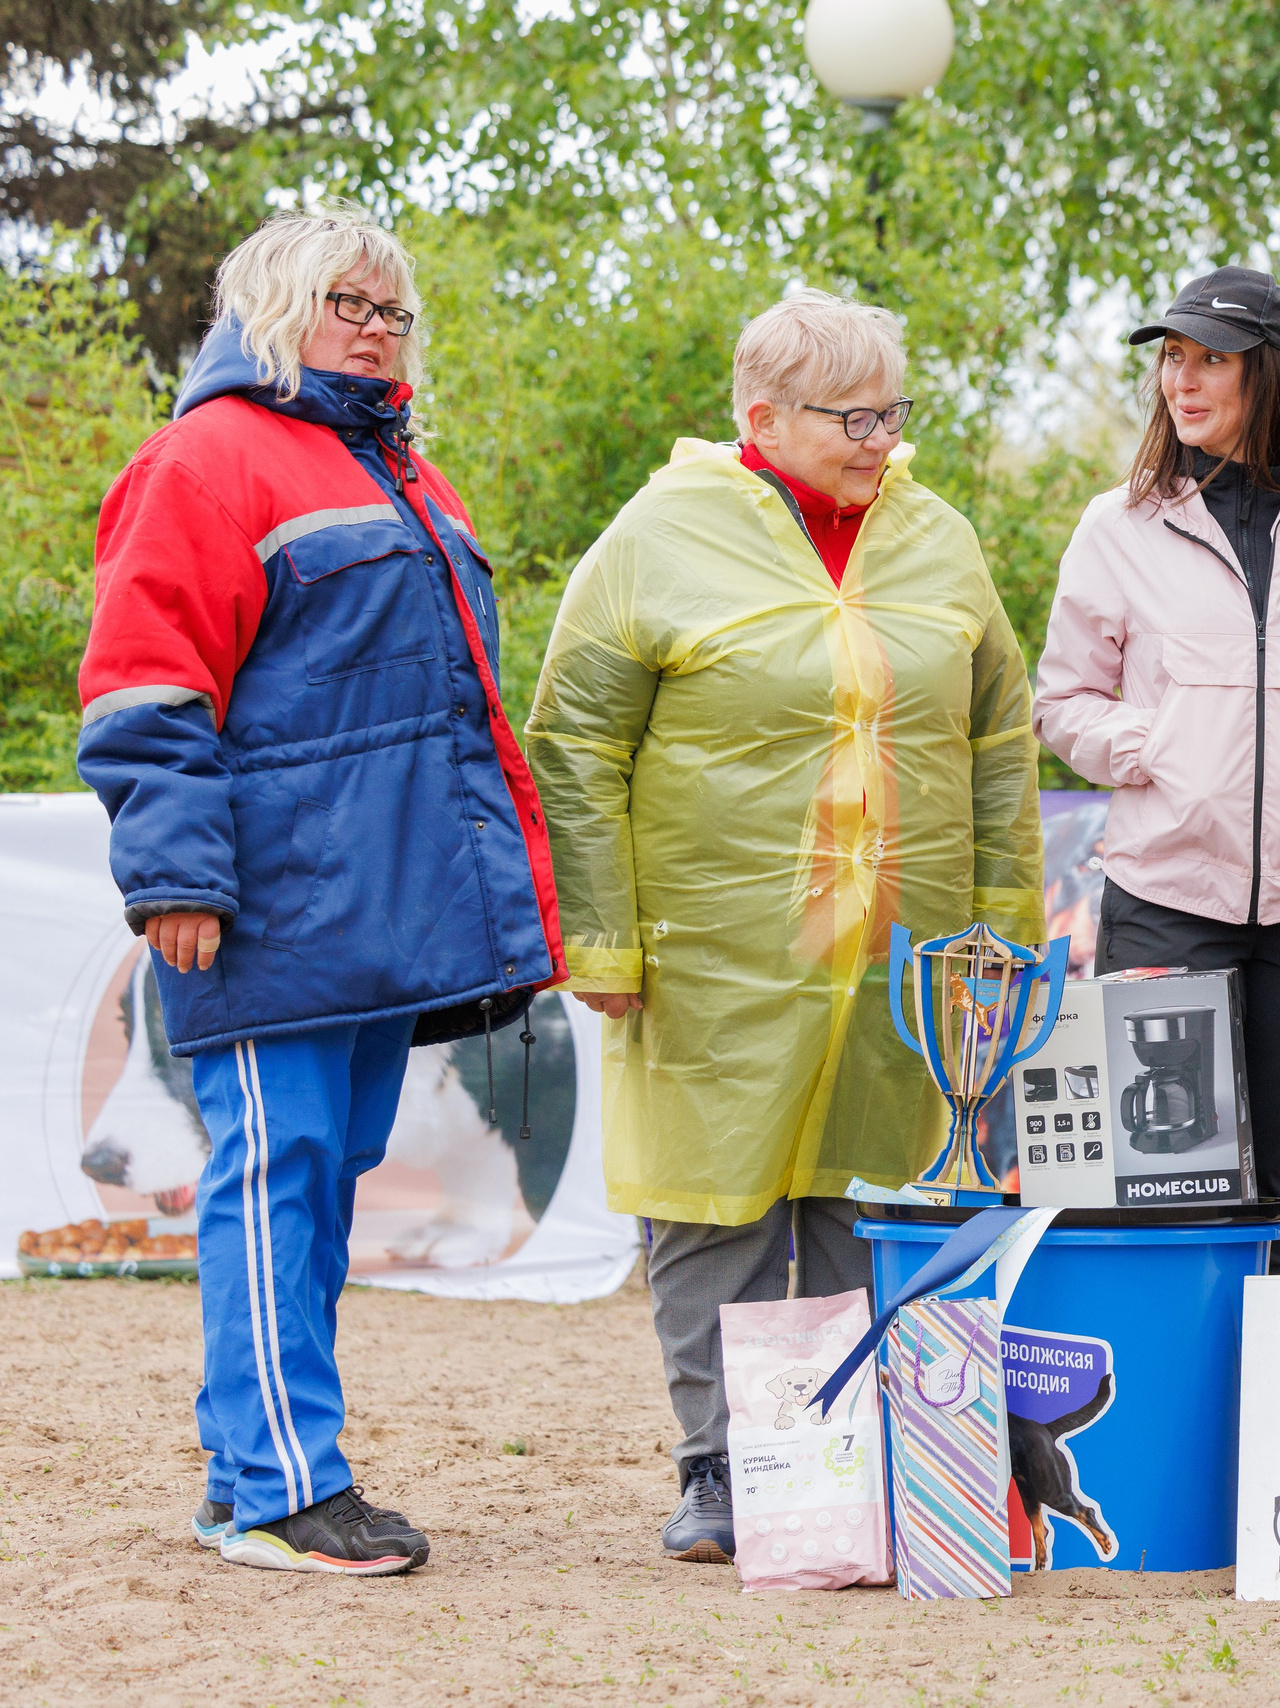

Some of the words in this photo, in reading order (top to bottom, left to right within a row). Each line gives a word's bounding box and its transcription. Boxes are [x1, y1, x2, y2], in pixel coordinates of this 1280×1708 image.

[1127, 1178, 1231, 1198] HOMECLUB
[842, 1434, 855, 1451] 7
[742, 1454, 777, 1465] КУРИЦА
[750, 1461, 792, 1473] ИНДЕЙКА
